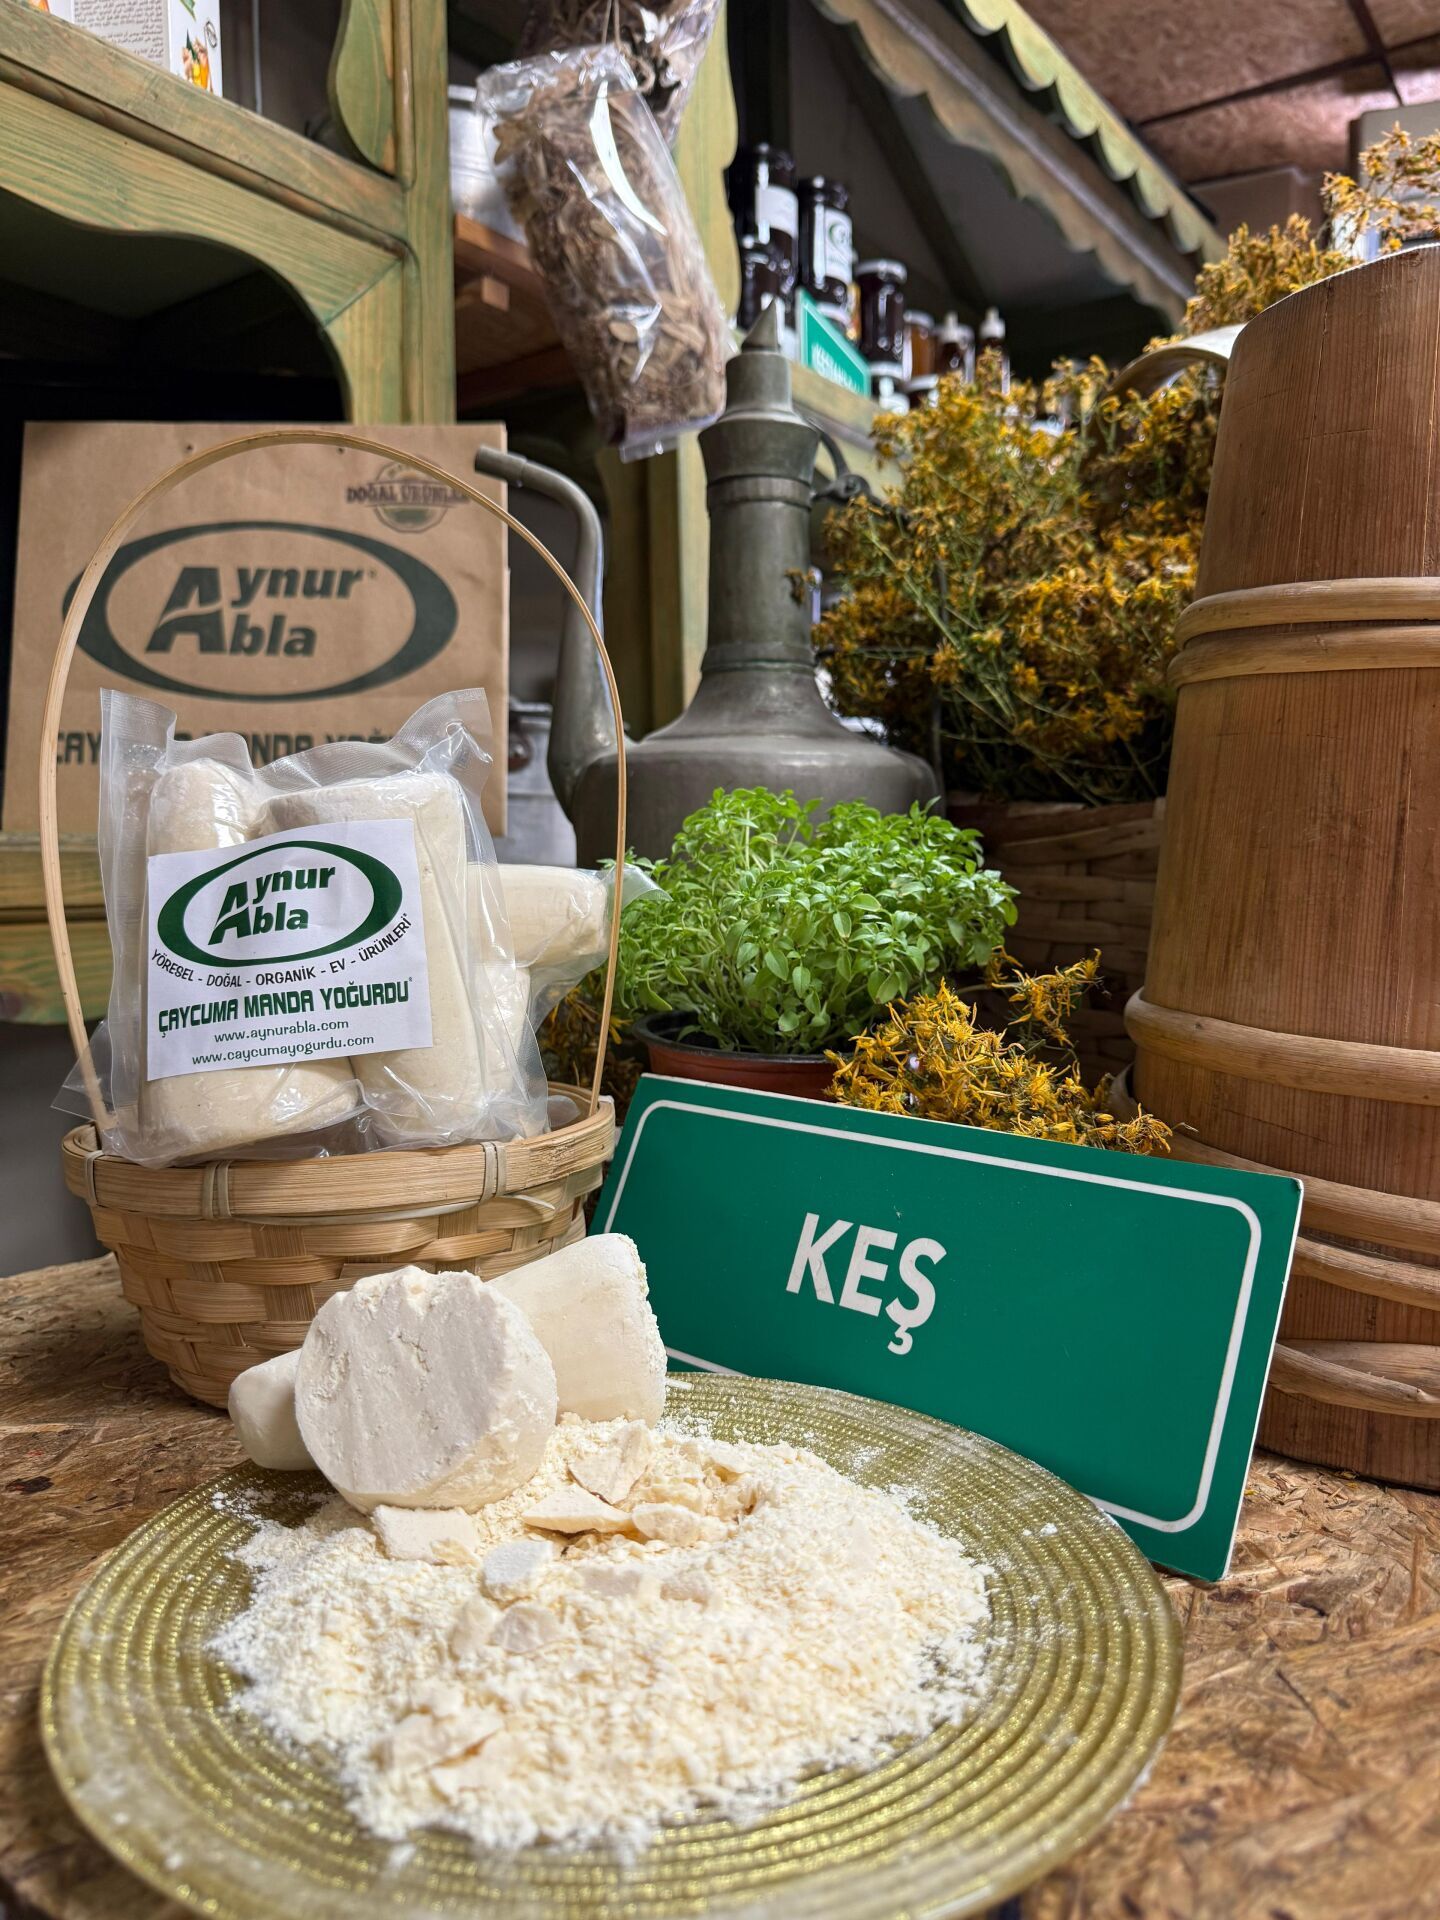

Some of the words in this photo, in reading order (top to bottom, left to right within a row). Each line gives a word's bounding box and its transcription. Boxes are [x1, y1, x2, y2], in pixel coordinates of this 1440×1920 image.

[145, 608, 318, 656] Abla
[207, 901, 309, 946] Abla
[151, 949, 195, 982] YÖRESEL
[206, 973, 242, 988] DOĞAL
[255, 965, 317, 986] ORGANİK
[329, 958, 346, 974] EV
[358, 915, 412, 962] ÜRÜNLERİ
[158, 998, 239, 1038] ÇAYCUMA
[244, 989, 315, 1019] MANDA
[319, 980, 410, 1011] YOĞURDU
[214, 1019, 349, 1043] www.aynurabla.com
[191, 1036, 375, 1065] www.caycumayogurdu.com
[785, 1212, 947, 1355] KEŞ
